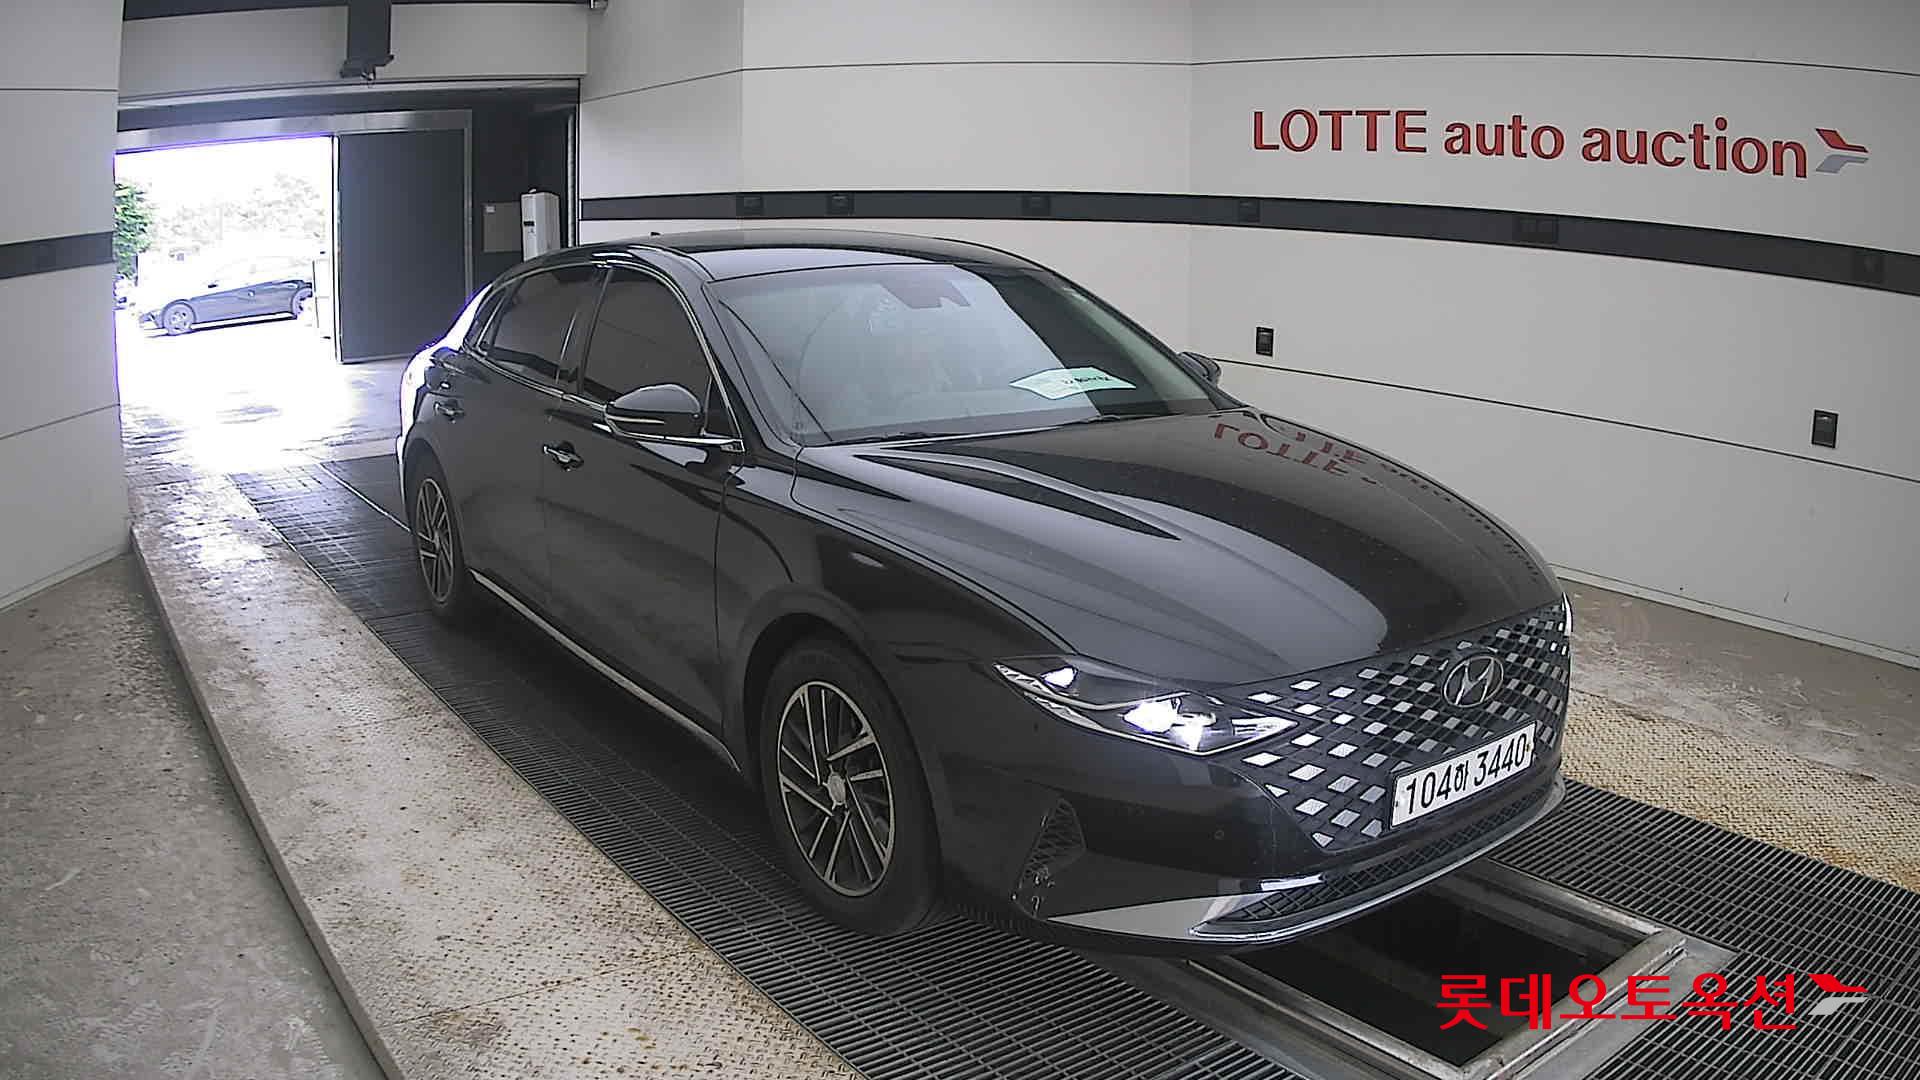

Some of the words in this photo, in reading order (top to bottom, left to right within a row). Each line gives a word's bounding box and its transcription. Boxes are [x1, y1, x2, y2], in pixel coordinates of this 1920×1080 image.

[1252, 110, 1427, 153] LOTTE
[1443, 114, 1565, 159] auto
[1581, 116, 1808, 178] auction
[1405, 759, 1470, 815] 104하
[1473, 733, 1528, 787] 3440
